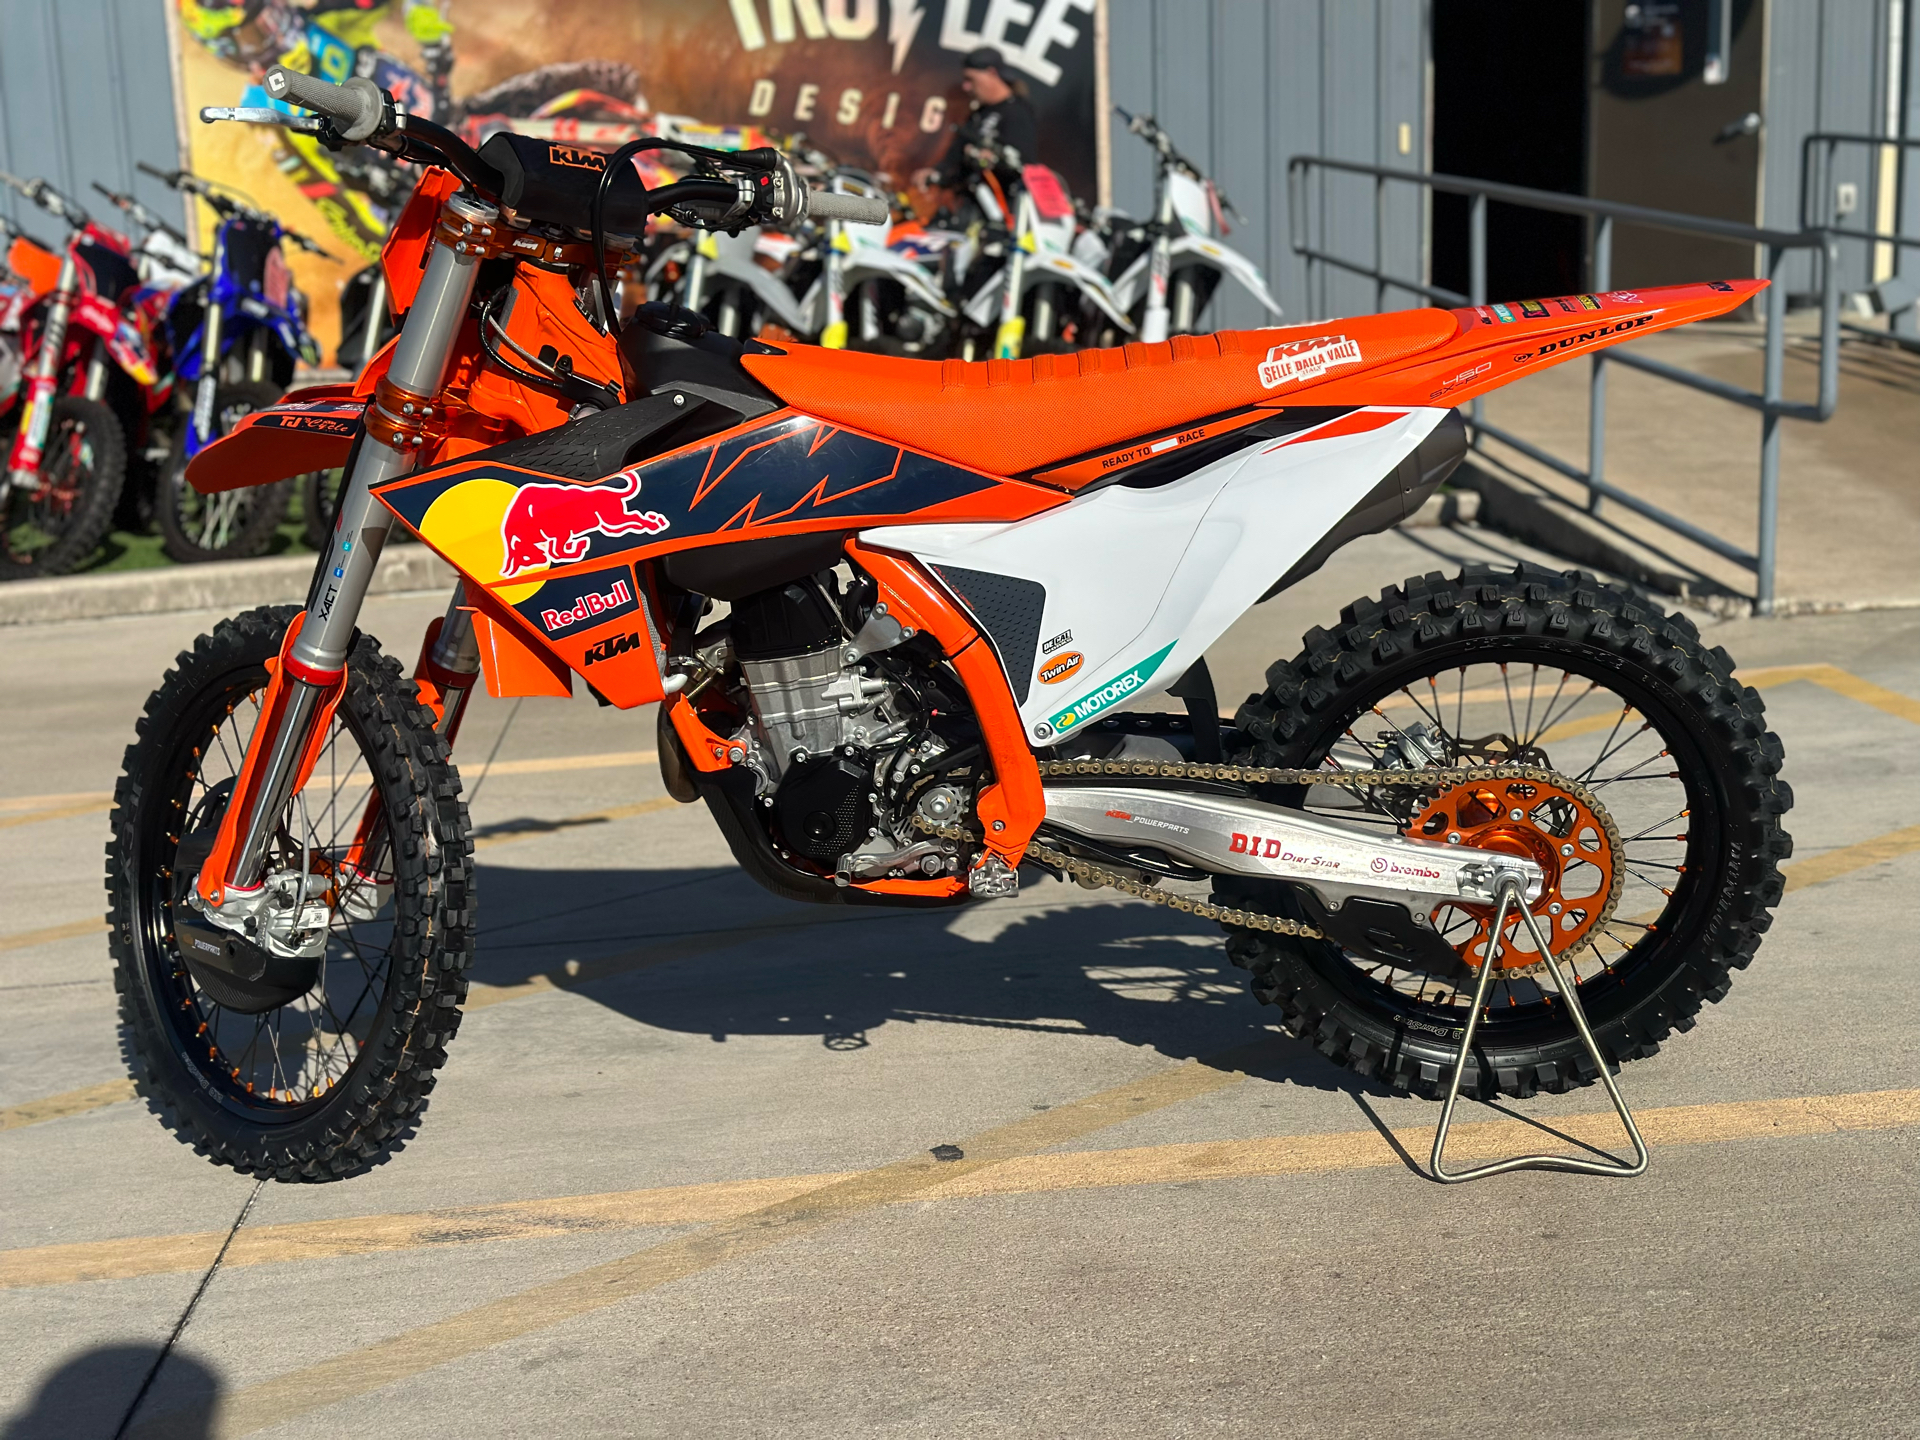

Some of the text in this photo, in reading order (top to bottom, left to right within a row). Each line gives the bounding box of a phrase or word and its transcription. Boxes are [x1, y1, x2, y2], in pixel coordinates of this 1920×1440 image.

[938, 0, 1095, 87] LEE
[549, 145, 607, 172] KTM
[1271, 335, 1343, 363] KTM
[1537, 314, 1655, 357] DUNLOP
[1263, 341, 1358, 384] SELLE DALLA VALLE
[1442, 361, 1493, 386] 450
[1102, 428, 1206, 469] READY TO RACE
[318, 584, 338, 621] XACT
[541, 579, 632, 632] Red Bull
[584, 631, 641, 667] KTM
[1041, 653, 1081, 682] Twin Air
[1073, 669, 1145, 719] MOTOREX
[1133, 815, 1190, 835] POWERPARTS
[1390, 862, 1441, 879] brembo
